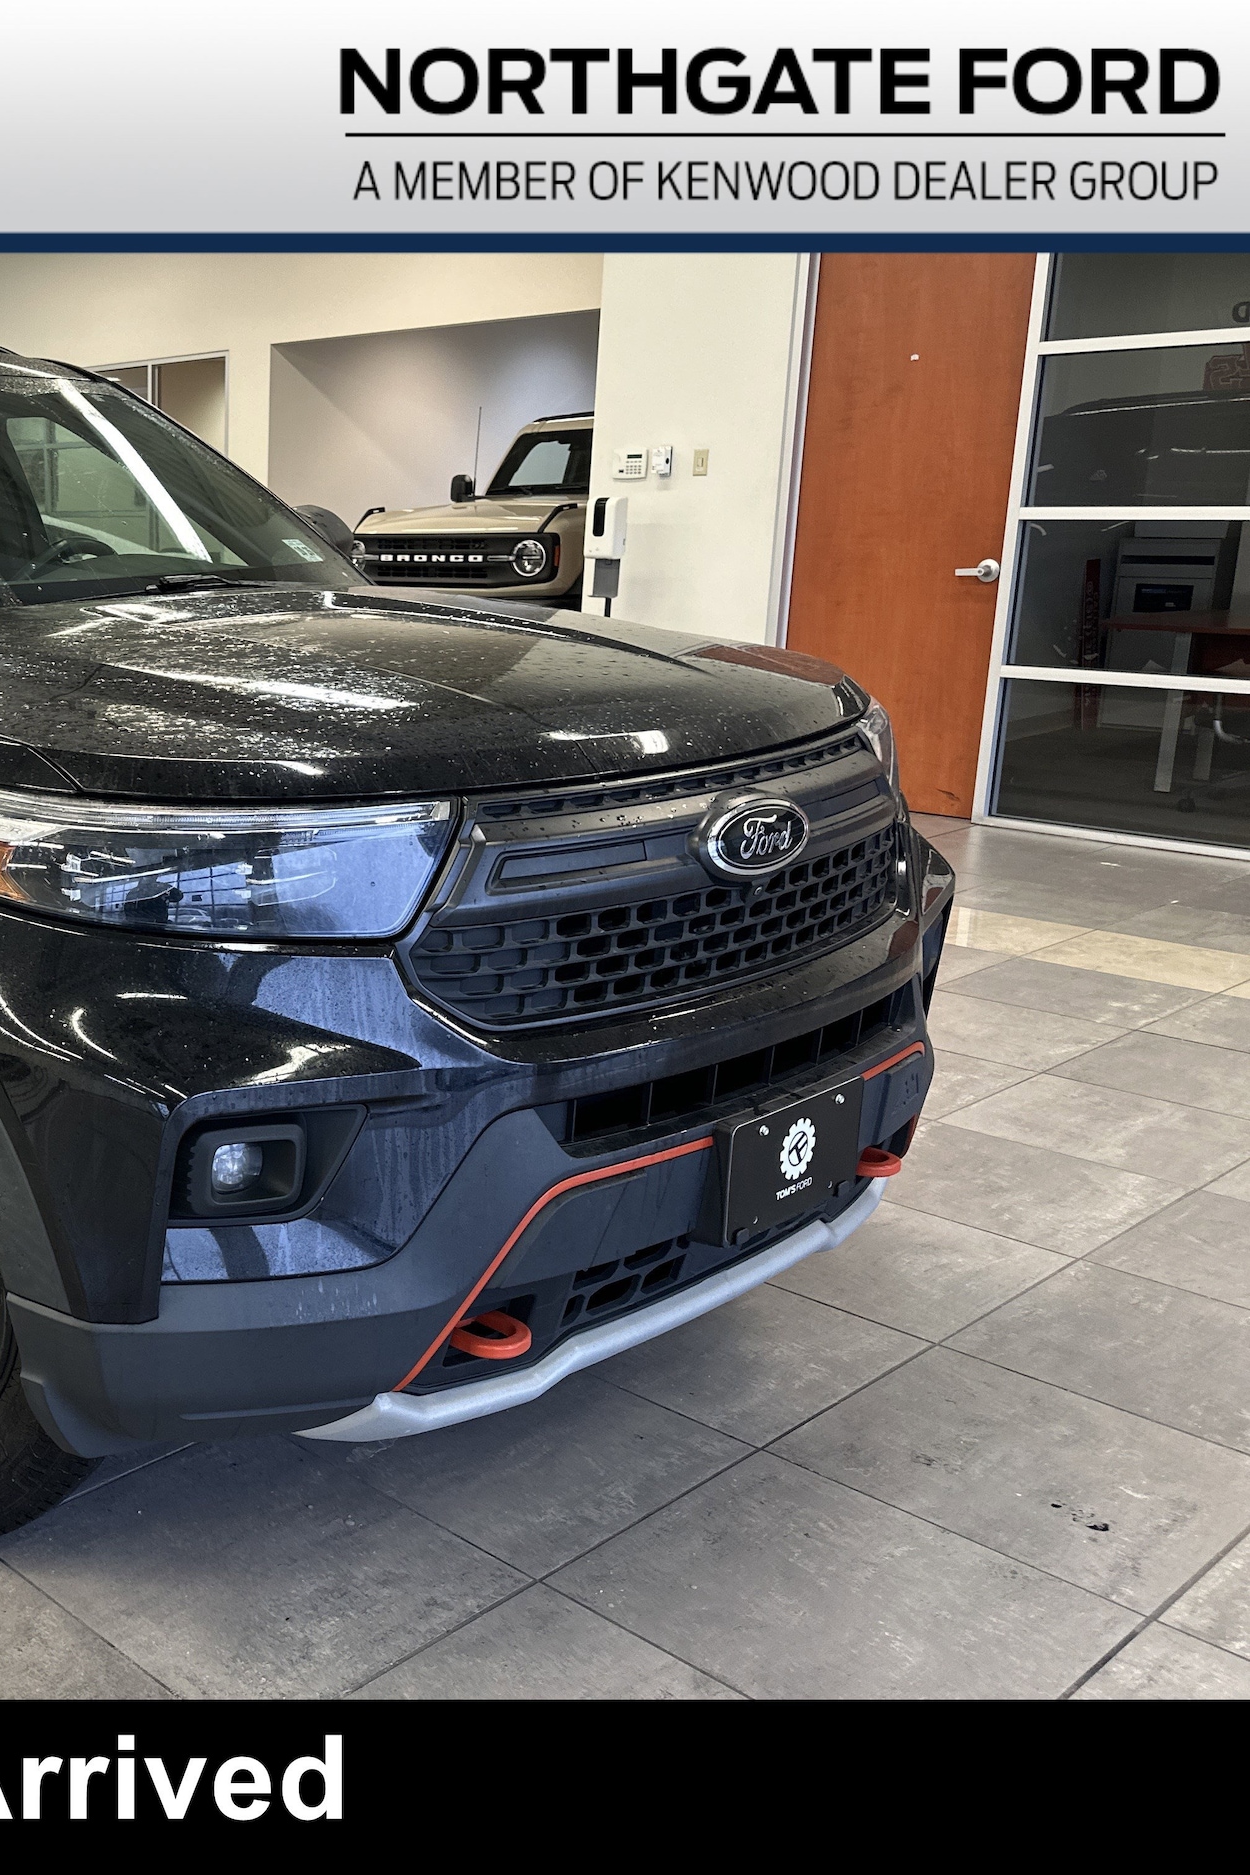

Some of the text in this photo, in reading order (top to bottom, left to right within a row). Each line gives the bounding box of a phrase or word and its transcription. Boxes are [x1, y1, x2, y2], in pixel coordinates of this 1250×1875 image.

[379, 554, 484, 563] BRONCO
[740, 814, 793, 860] Ford
[796, 1176, 813, 1191] FORD
